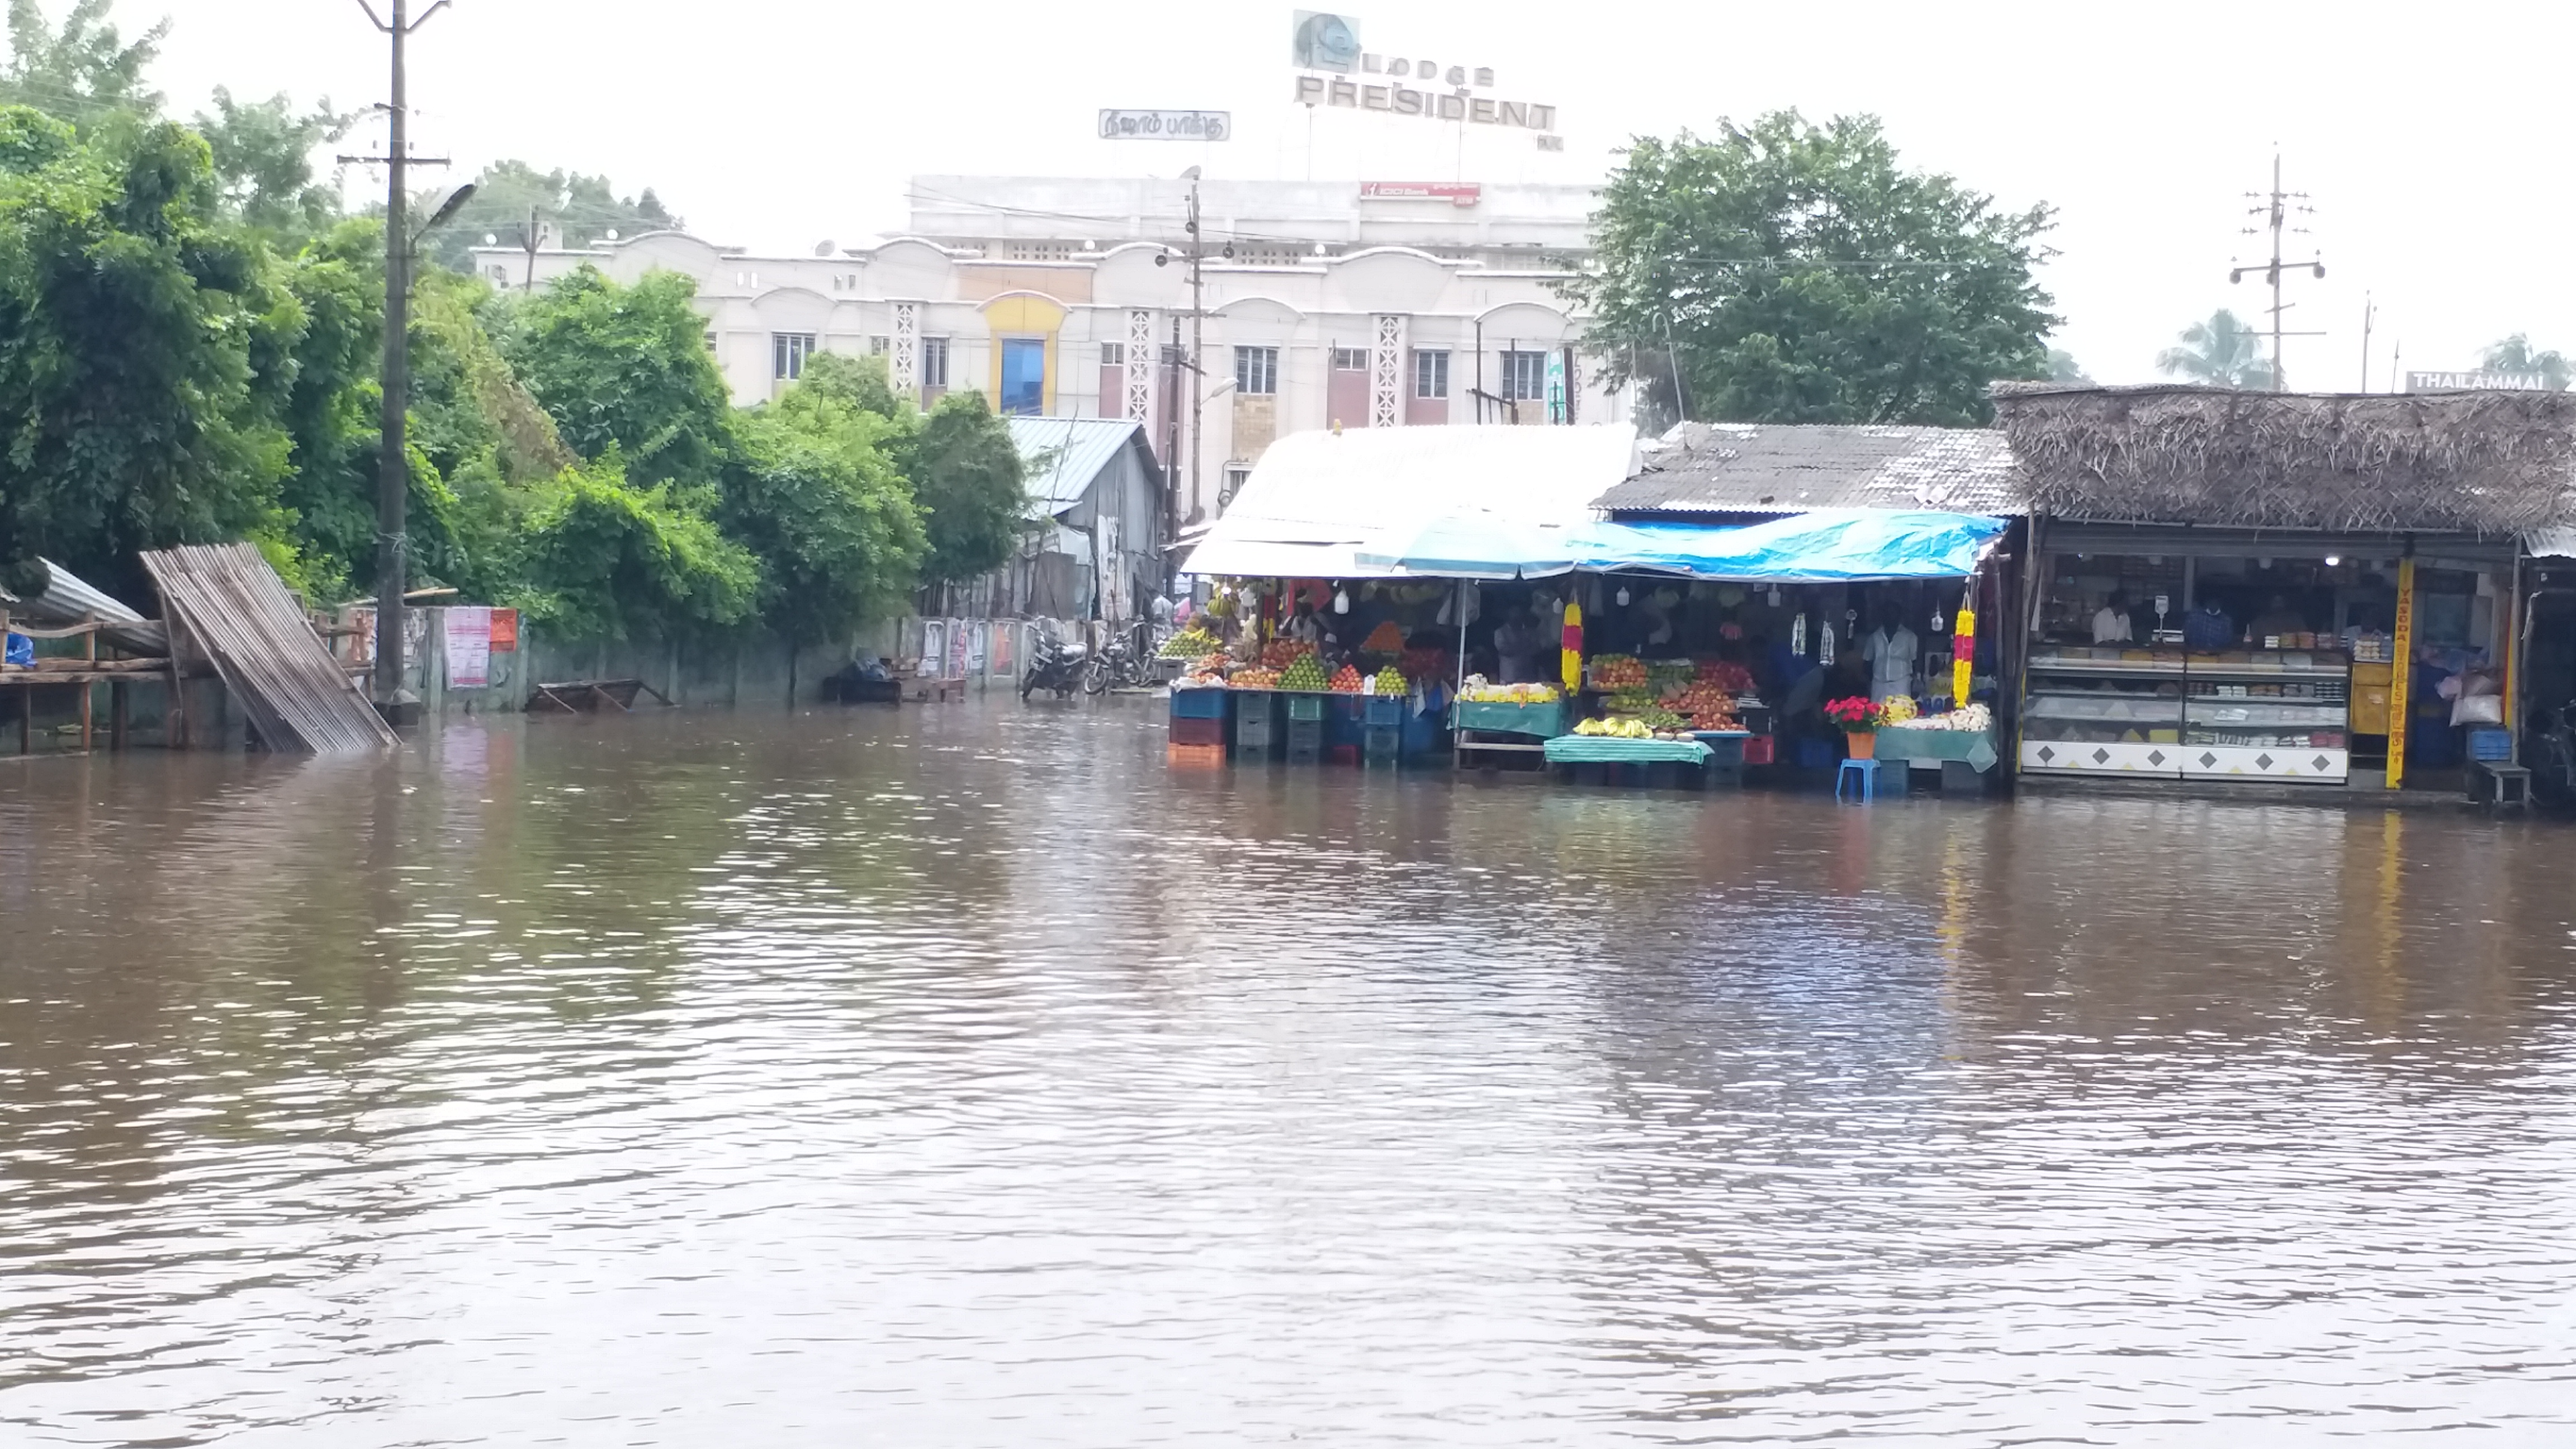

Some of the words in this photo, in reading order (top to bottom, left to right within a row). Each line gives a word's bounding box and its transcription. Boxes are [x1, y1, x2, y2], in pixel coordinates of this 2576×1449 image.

[1362, 53, 1494, 88] LODGE
[1296, 76, 1556, 131] PRESIDENT
[2414, 373, 2544, 390] THAILAMMAI
[2398, 589, 2411, 641] YASODA
